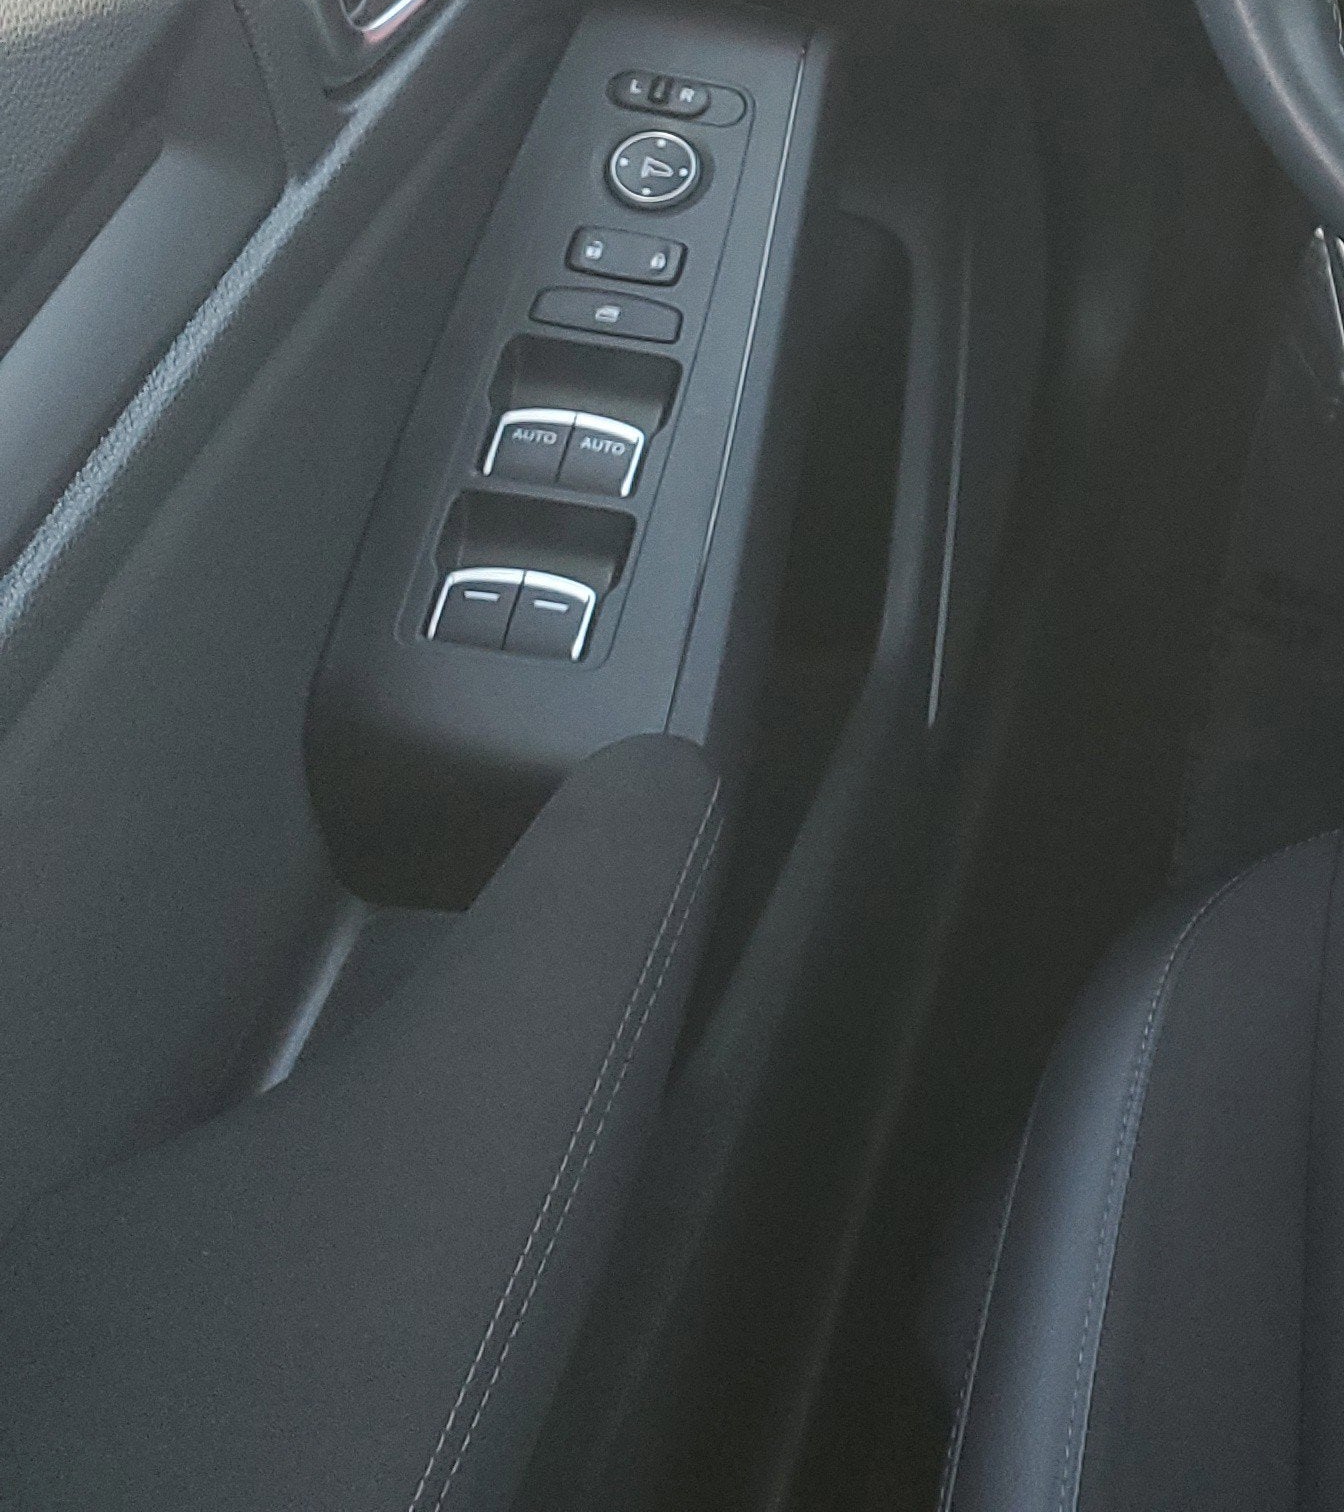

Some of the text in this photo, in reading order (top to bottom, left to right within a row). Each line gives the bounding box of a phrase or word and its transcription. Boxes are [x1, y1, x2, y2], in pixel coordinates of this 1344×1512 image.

[629, 78, 642, 94] L
[511, 427, 558, 446] AUTO
[580, 436, 627, 457] AUTO
